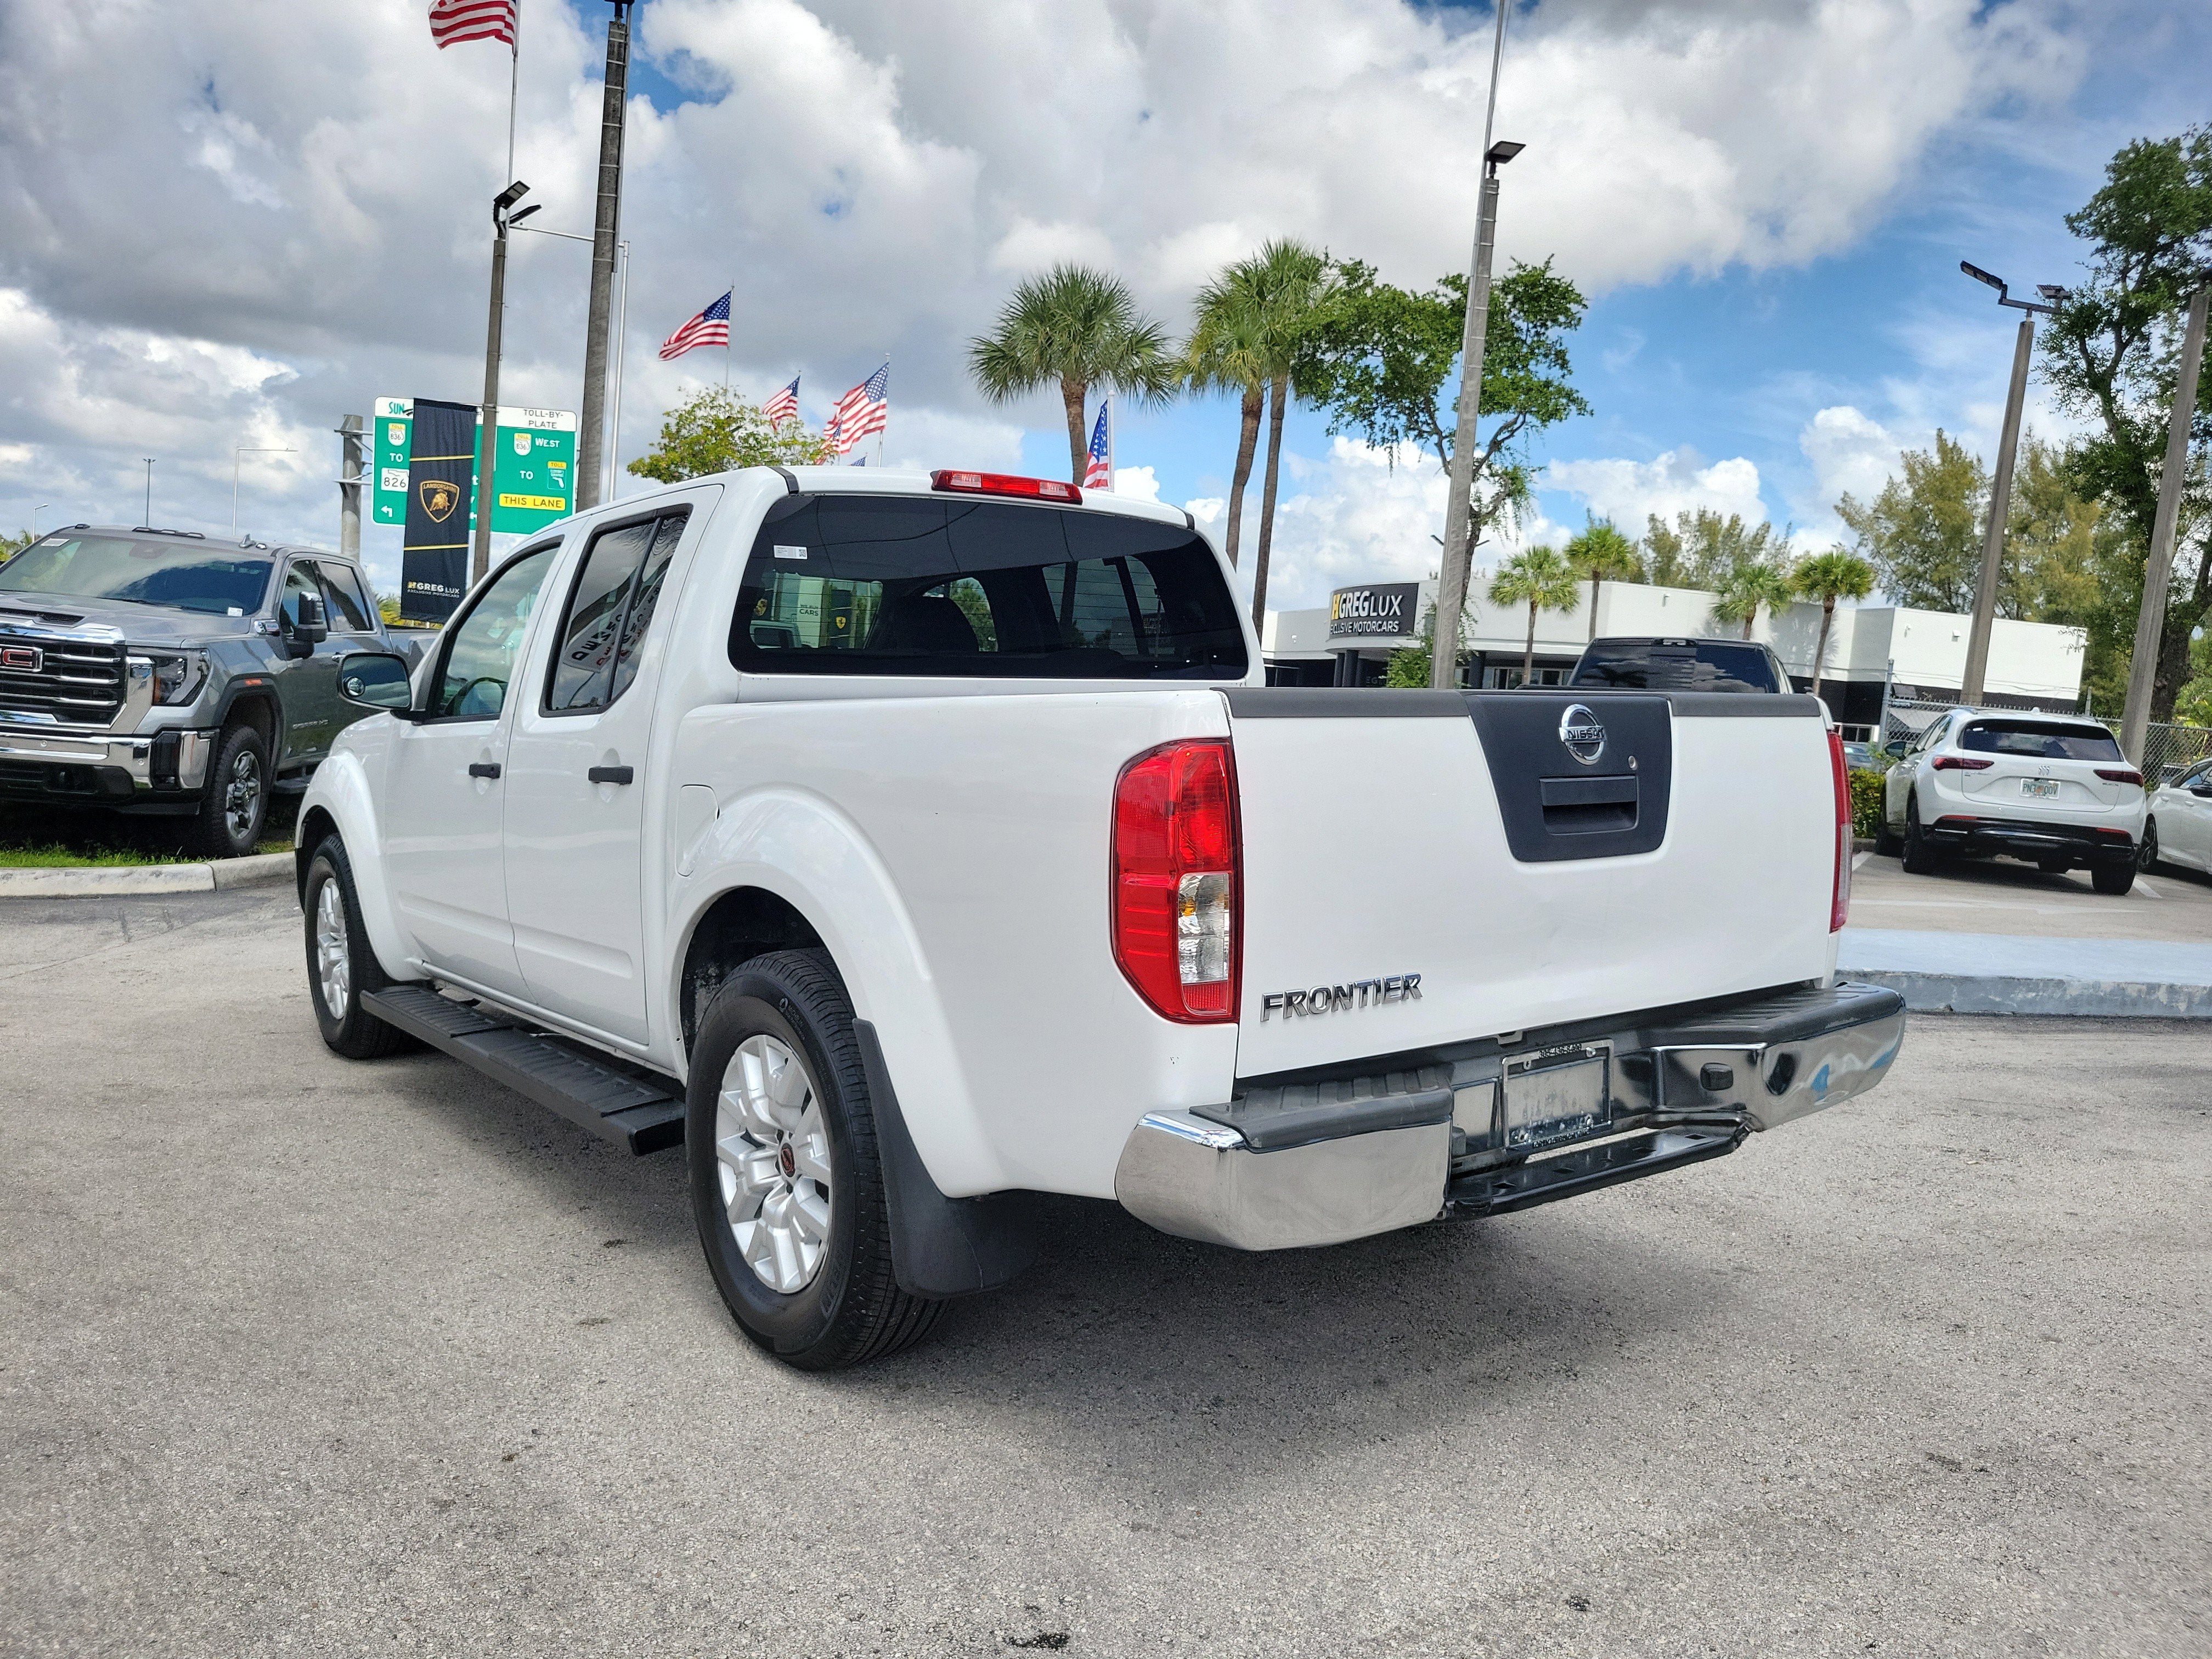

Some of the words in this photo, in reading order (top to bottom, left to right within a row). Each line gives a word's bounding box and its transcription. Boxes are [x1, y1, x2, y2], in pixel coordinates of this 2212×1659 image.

[388, 402, 405, 414] SUN
[523, 409, 564, 419] TOLL-BY-
[528, 420, 557, 429] PLATE
[535, 437, 561, 448] WEST
[389, 453, 404, 462] TO
[520, 470, 534, 480] TO
[383, 477, 407, 488] 826
[423, 483, 457, 493] LAMBORGHINI
[504, 496, 527, 505] THIS
[533, 498, 562, 508] LANE
[799, 608, 819, 617] CARS
[1353, 620, 1400, 633] MOTORCARS
[1567, 727, 1605, 739] NISSAN
[1260, 972, 1423, 1022] FRONTIER
